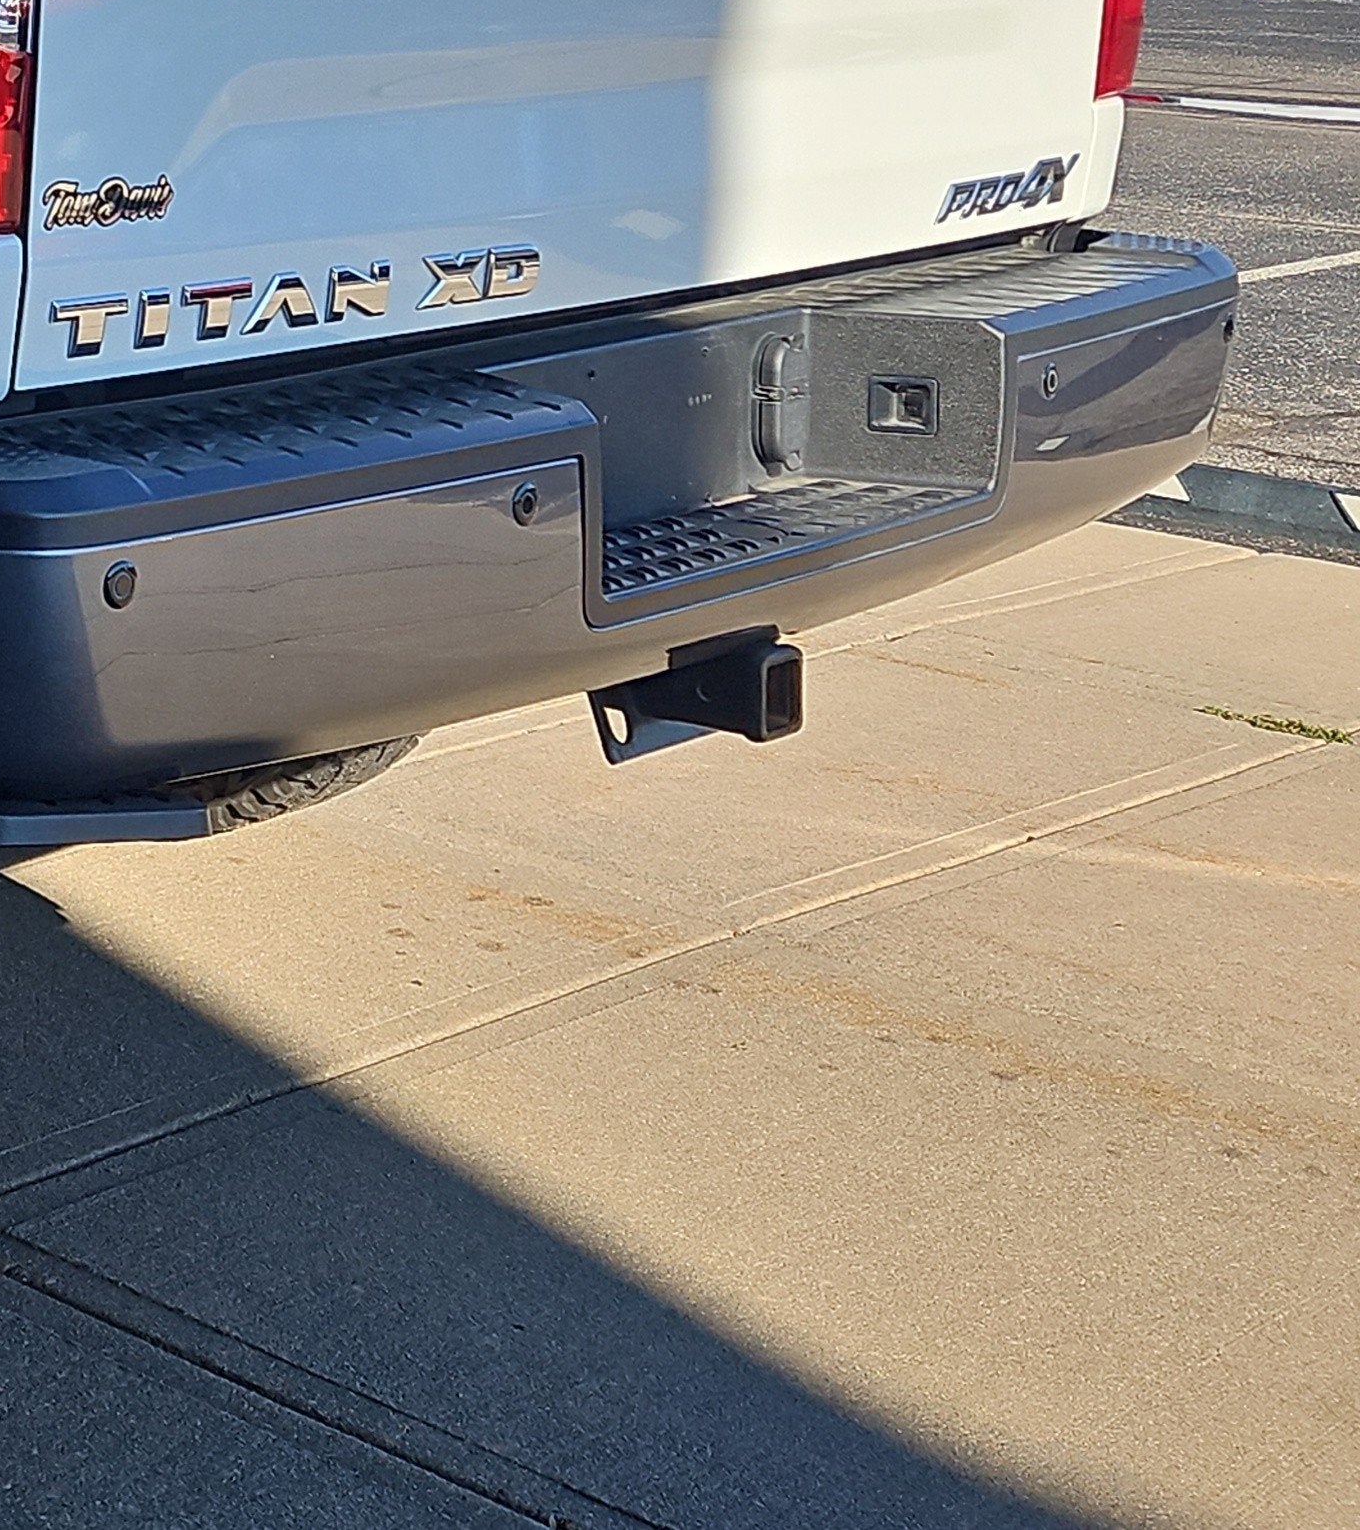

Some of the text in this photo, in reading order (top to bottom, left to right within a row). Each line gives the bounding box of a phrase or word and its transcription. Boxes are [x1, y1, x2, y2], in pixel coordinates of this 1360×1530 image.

[42, 173, 174, 232] Tom Davis
[49, 242, 542, 358] TITAN XD
